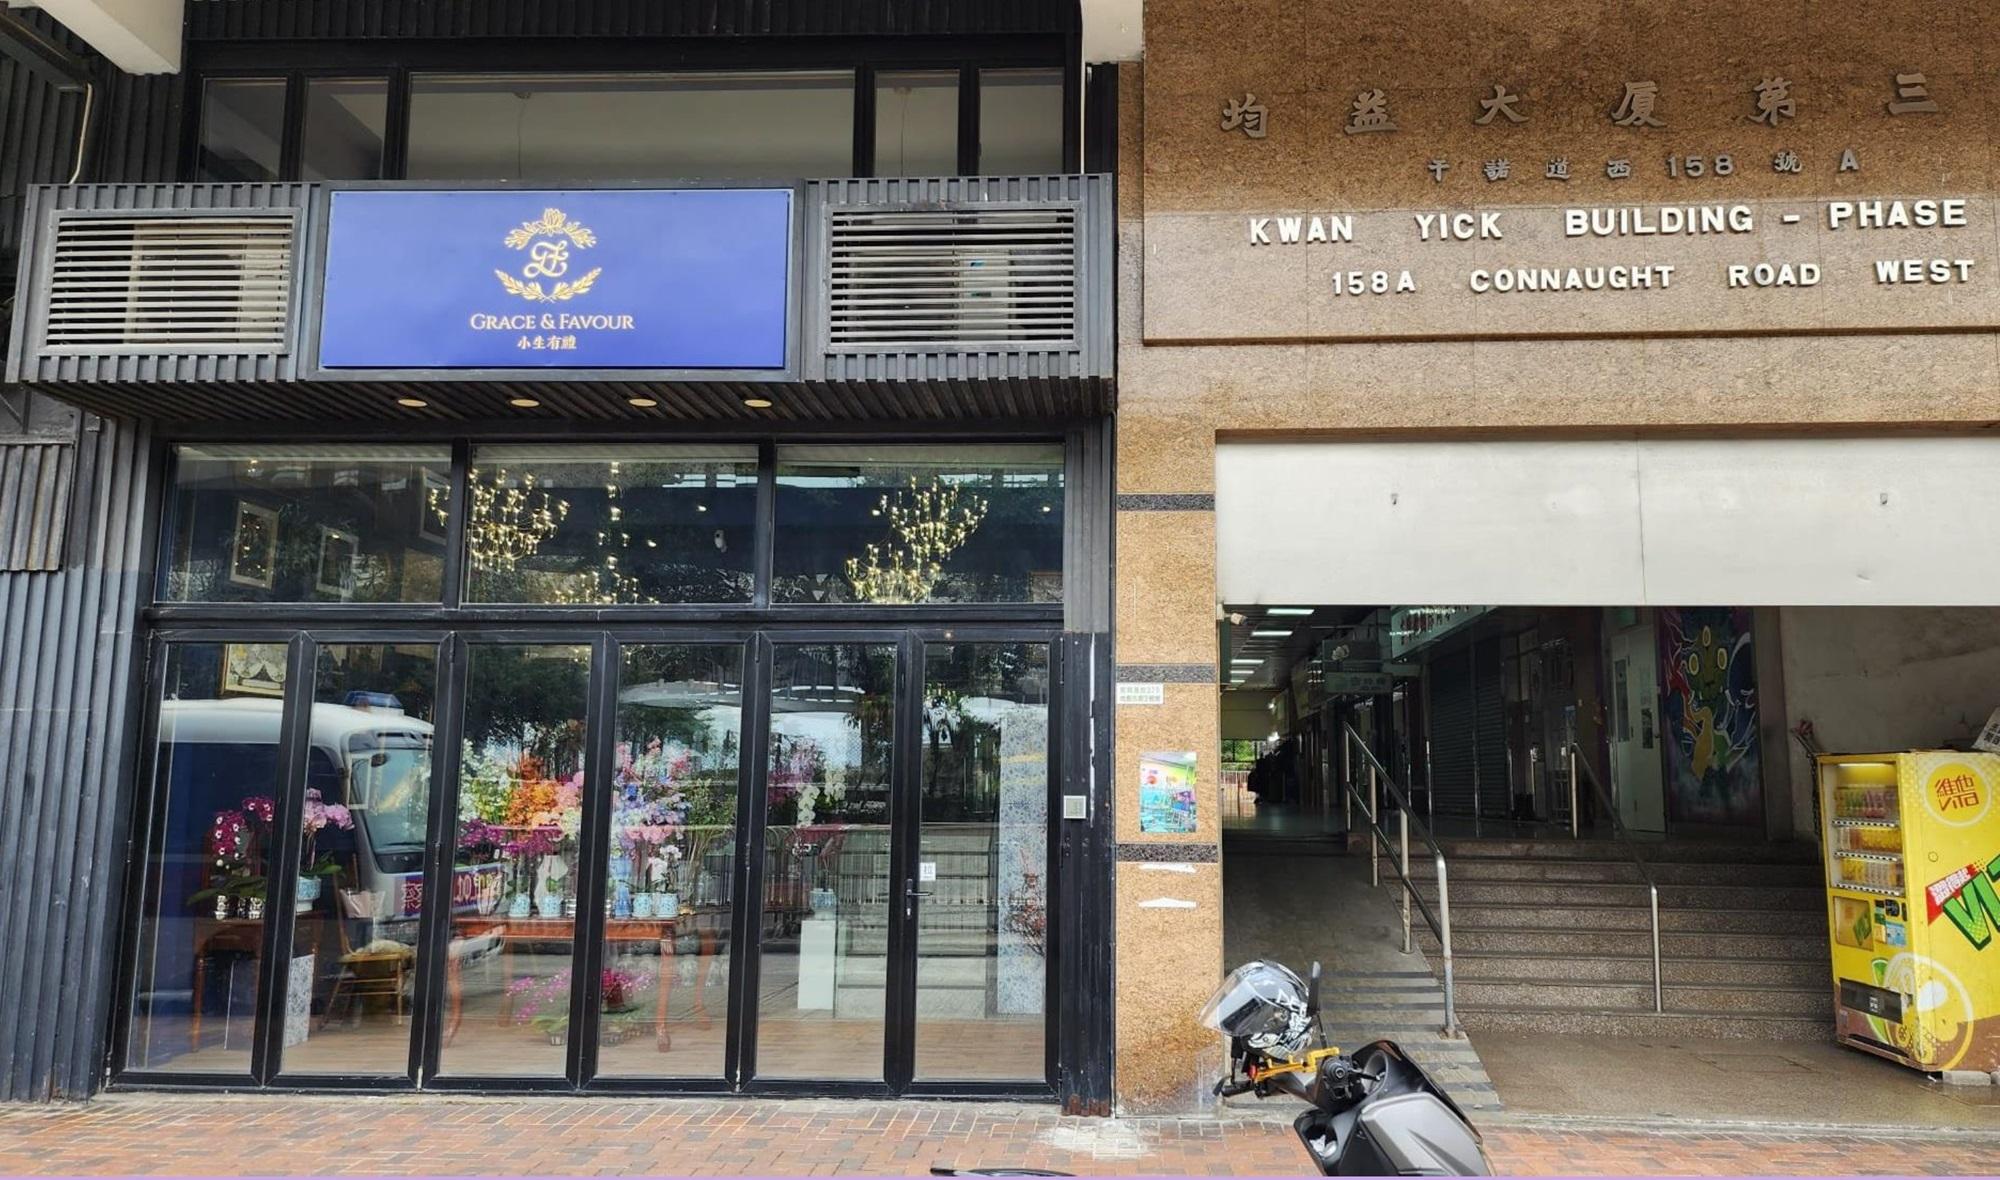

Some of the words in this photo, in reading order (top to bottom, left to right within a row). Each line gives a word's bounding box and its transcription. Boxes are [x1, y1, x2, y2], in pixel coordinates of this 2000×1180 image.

[1250, 215, 1353, 245] KWAN
[1415, 212, 1503, 240] YICK
[1565, 205, 1754, 236] BUILDING
[1830, 199, 1967, 229] PHASE
[1331, 270, 1416, 296] 158A
[1470, 265, 1675, 292] CONNAUGHT
[1729, 263, 1821, 287] ROAD
[1876, 259, 1975, 284] WEST
[540, 313, 557, 329] &
